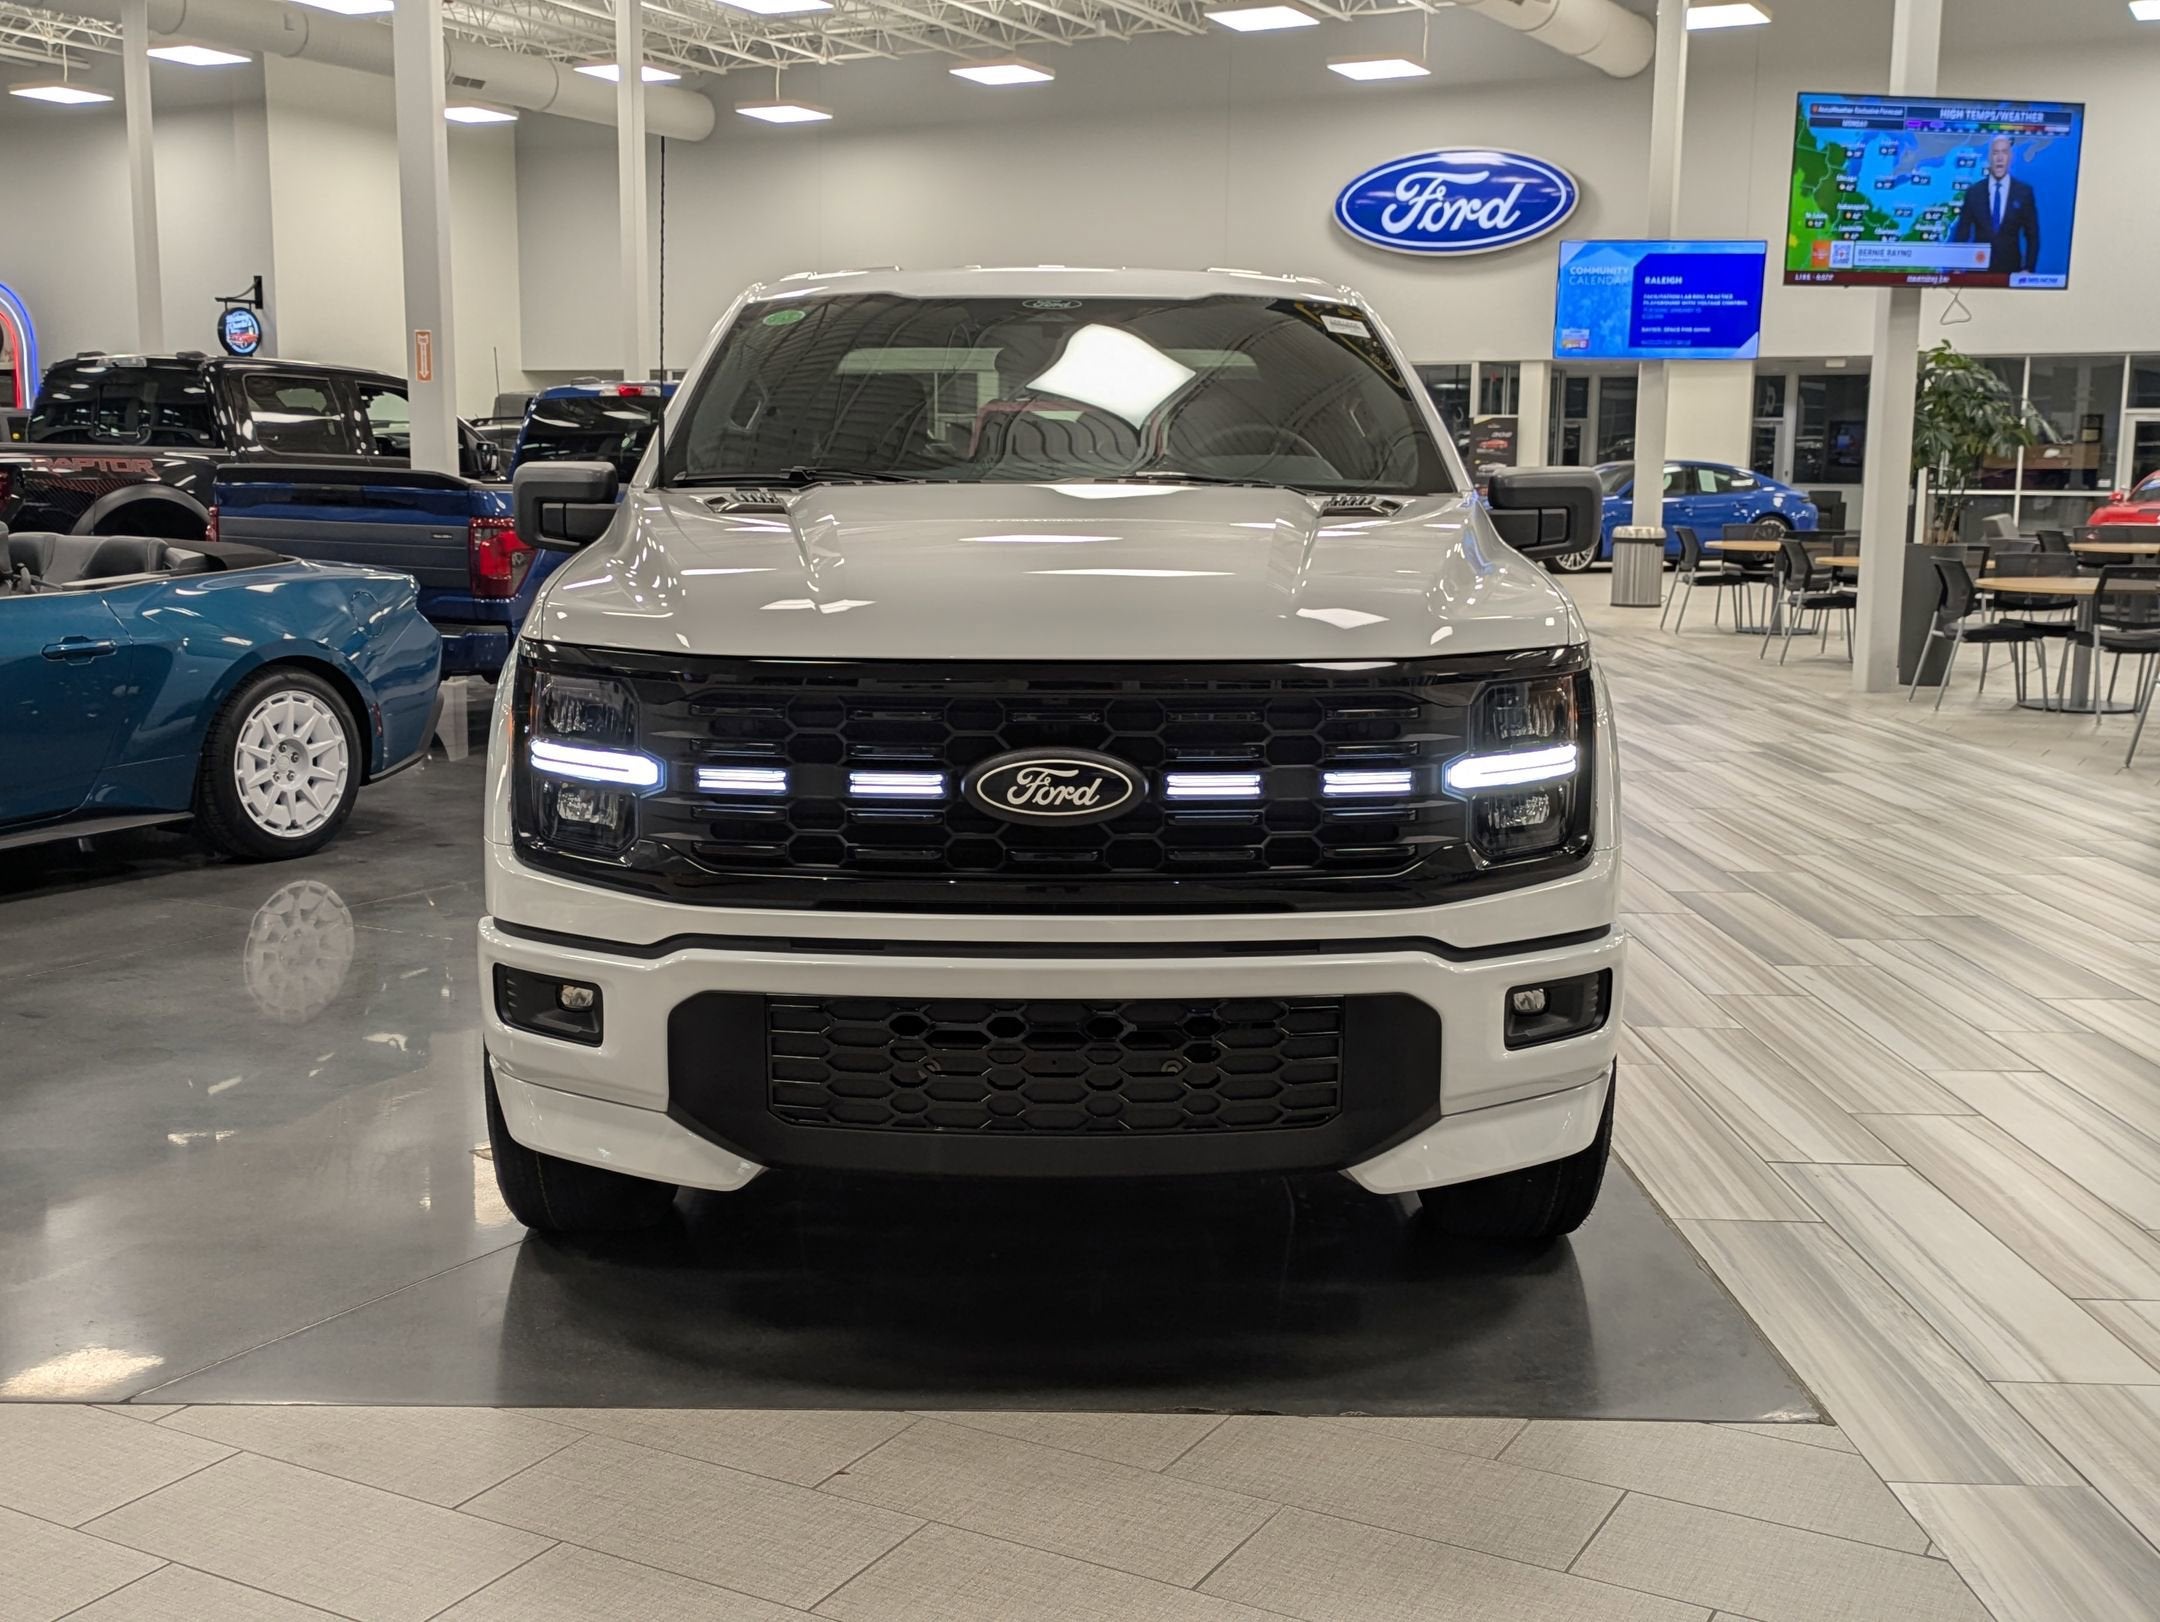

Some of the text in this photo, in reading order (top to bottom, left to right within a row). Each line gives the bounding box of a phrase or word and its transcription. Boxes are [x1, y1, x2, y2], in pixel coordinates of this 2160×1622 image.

[1940, 108, 2044, 122] HIGH TEMPS/WEATHER
[1381, 170, 1520, 234] Ford
[1858, 248, 1884, 256] BERNIE
[1569, 266, 1628, 275] COMMUNITY
[1568, 276, 1628, 286] CALENDAR
[1644, 276, 1683, 285] RALEIGH
[30, 457, 160, 481] RAPTOR
[1007, 767, 1101, 806] Ford
